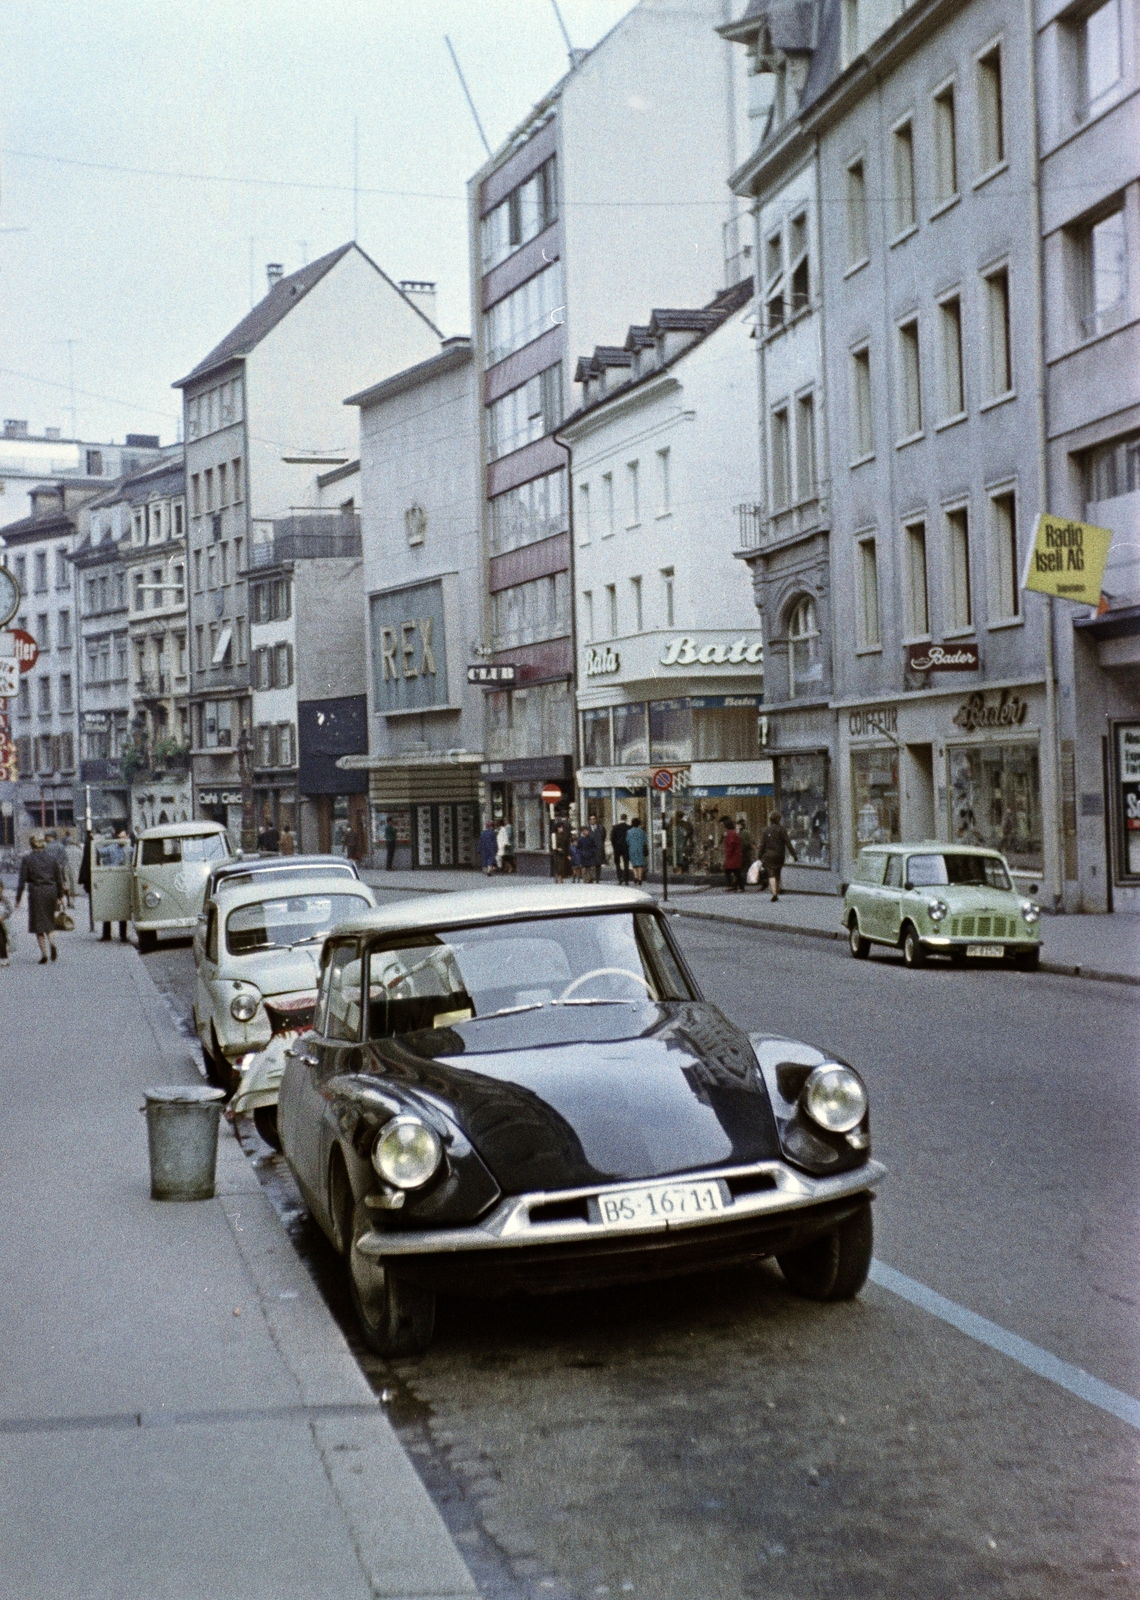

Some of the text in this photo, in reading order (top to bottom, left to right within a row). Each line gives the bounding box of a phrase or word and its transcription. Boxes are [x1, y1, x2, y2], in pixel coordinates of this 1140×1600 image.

[1045, 523, 1083, 548] Radio
[1066, 548, 1084, 571] AG
[381, 615, 436, 681] REX
[661, 636, 764, 666] Bata
[911, 647, 976, 670] Bader
[583, 648, 621, 676] Bata
[726, 786, 759, 797] Bata
